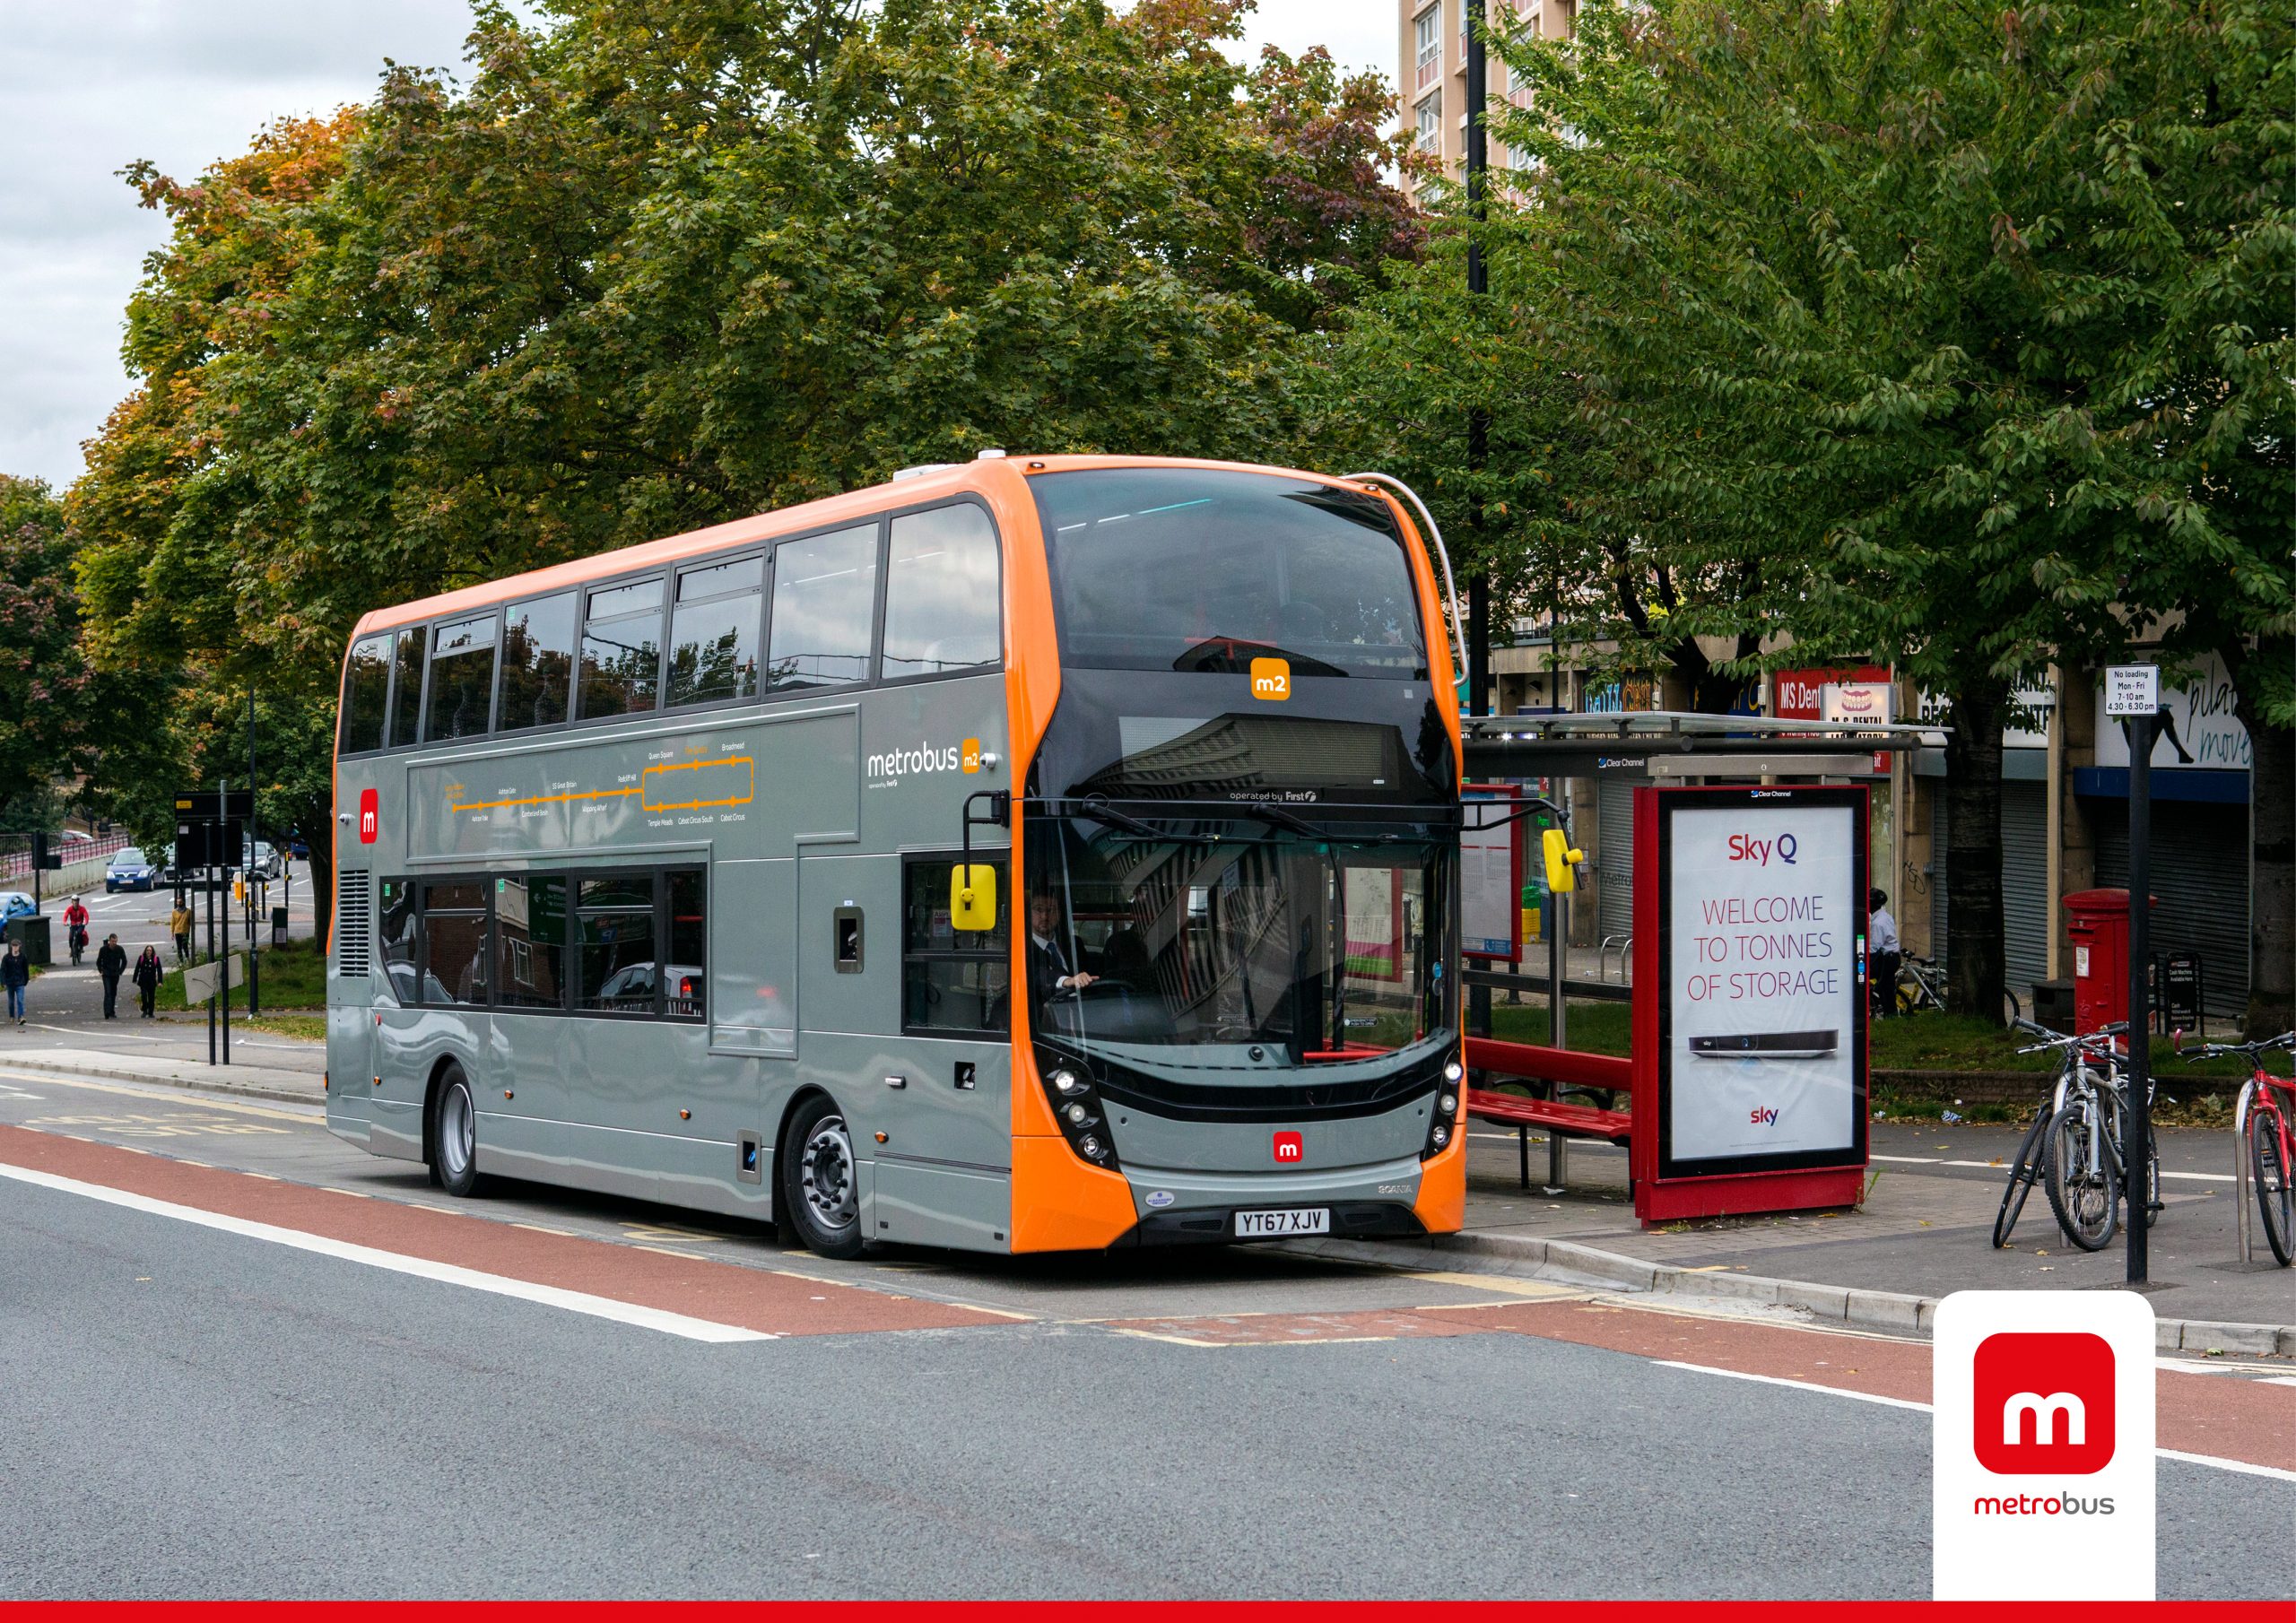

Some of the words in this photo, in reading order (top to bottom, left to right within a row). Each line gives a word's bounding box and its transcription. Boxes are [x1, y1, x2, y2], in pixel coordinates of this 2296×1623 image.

[1256, 675, 1286, 692] m2
[2126, 670, 2149, 679] loading
[2118, 682, 2132, 690] Mon
[2135, 681, 2145, 690] Fri
[1780, 682, 1796, 709] MS
[1798, 683, 1821, 709] Dent
[721, 742, 745, 751] Broadmead
[867, 741, 958, 777] metrobus
[964, 752, 978, 767] m2
[1606, 759, 1622, 768] Clear
[1622, 758, 1645, 768] Channel
[1230, 792, 1270, 801] operated
[1271, 792, 1283, 803] by
[1285, 791, 1305, 801] First
[1728, 833, 1772, 866] Sky
[1777, 833, 1797, 864] Q
[1702, 896, 1824, 925] WELCOME
[1693, 936, 1727, 963] TO
[1735, 932, 1832, 960] TONNES
[1687, 974, 1721, 1001] OF
[1729, 968, 1839, 1000] STORAGE
[1750, 1106, 1779, 1127] sky
[1279, 1142, 1298, 1158] m
[1243, 1213, 1286, 1232] YT67
[1291, 1211, 1322, 1229] XJV
